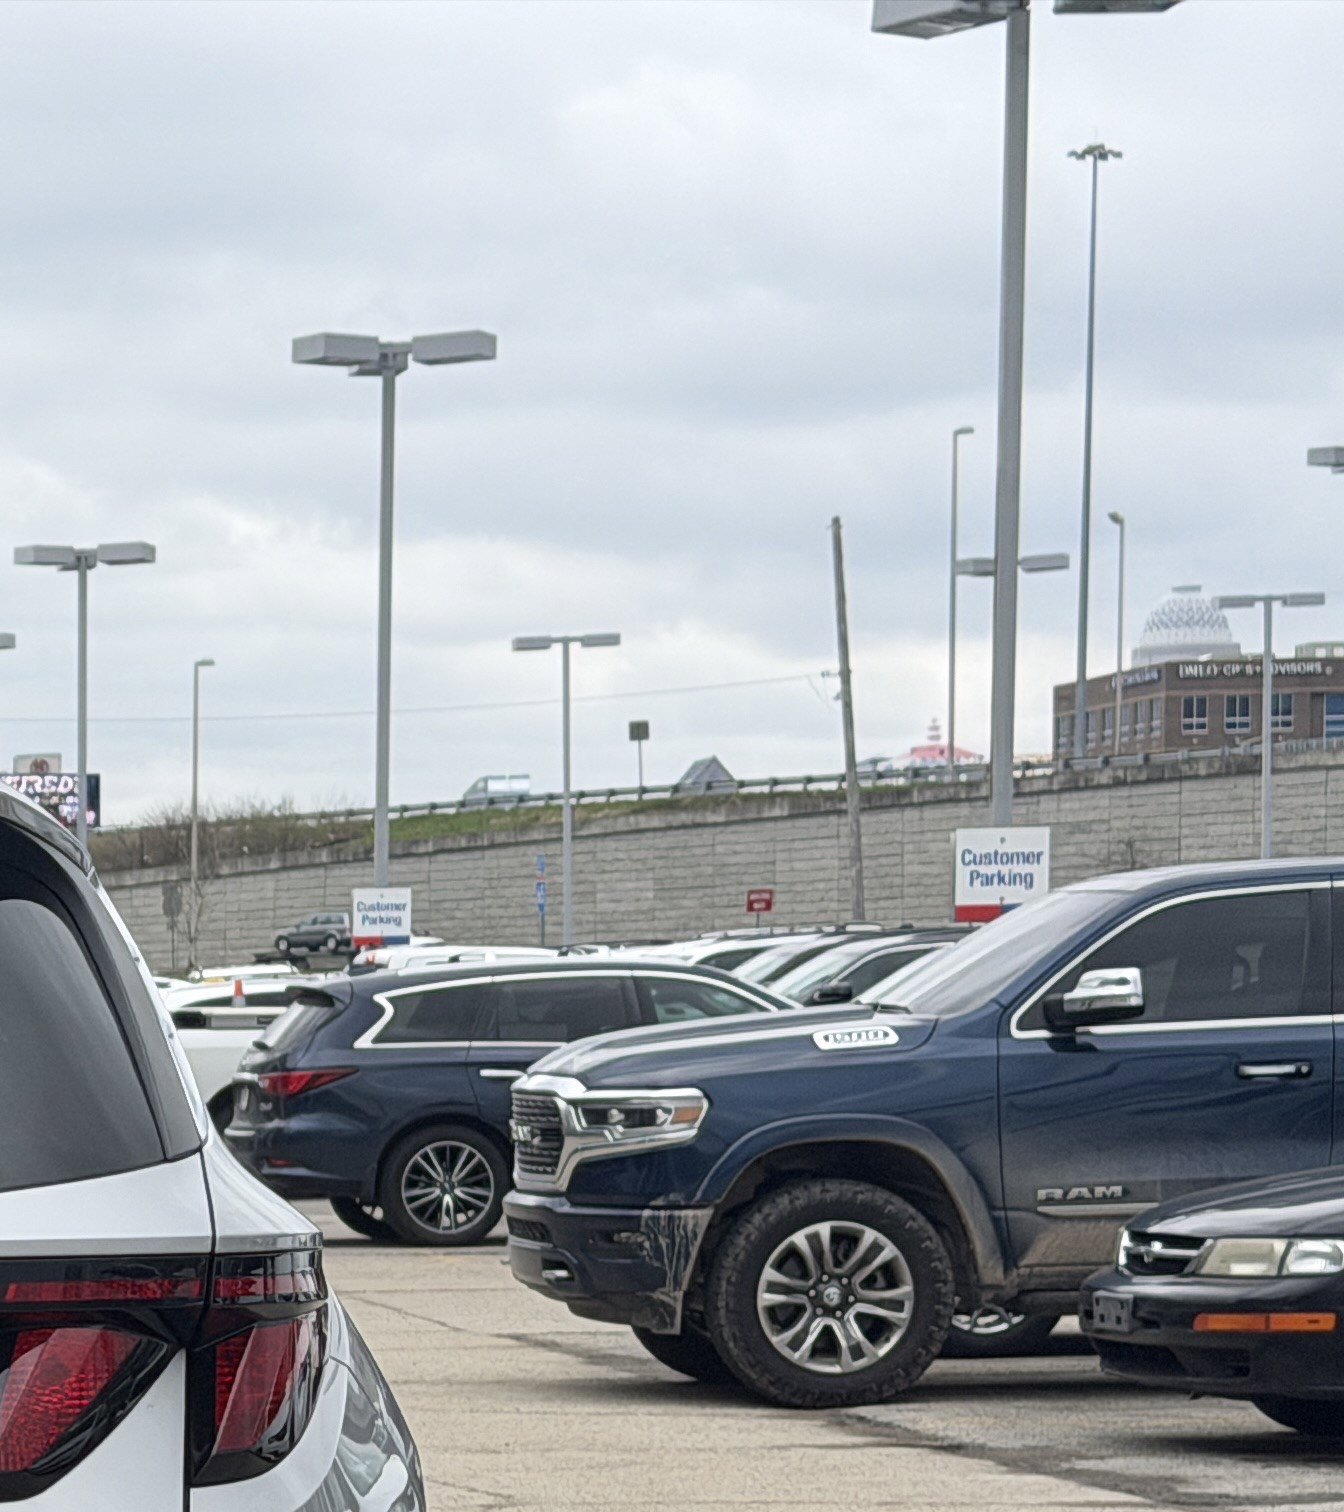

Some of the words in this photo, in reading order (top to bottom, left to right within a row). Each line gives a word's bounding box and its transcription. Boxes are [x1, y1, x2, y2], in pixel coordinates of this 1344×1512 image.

[961, 848, 1044, 866] Customer
[969, 869, 1034, 890] Parking
[357, 901, 407, 912] Customer
[362, 914, 402, 927] Parking
[1037, 1185, 1123, 1201] RAM
